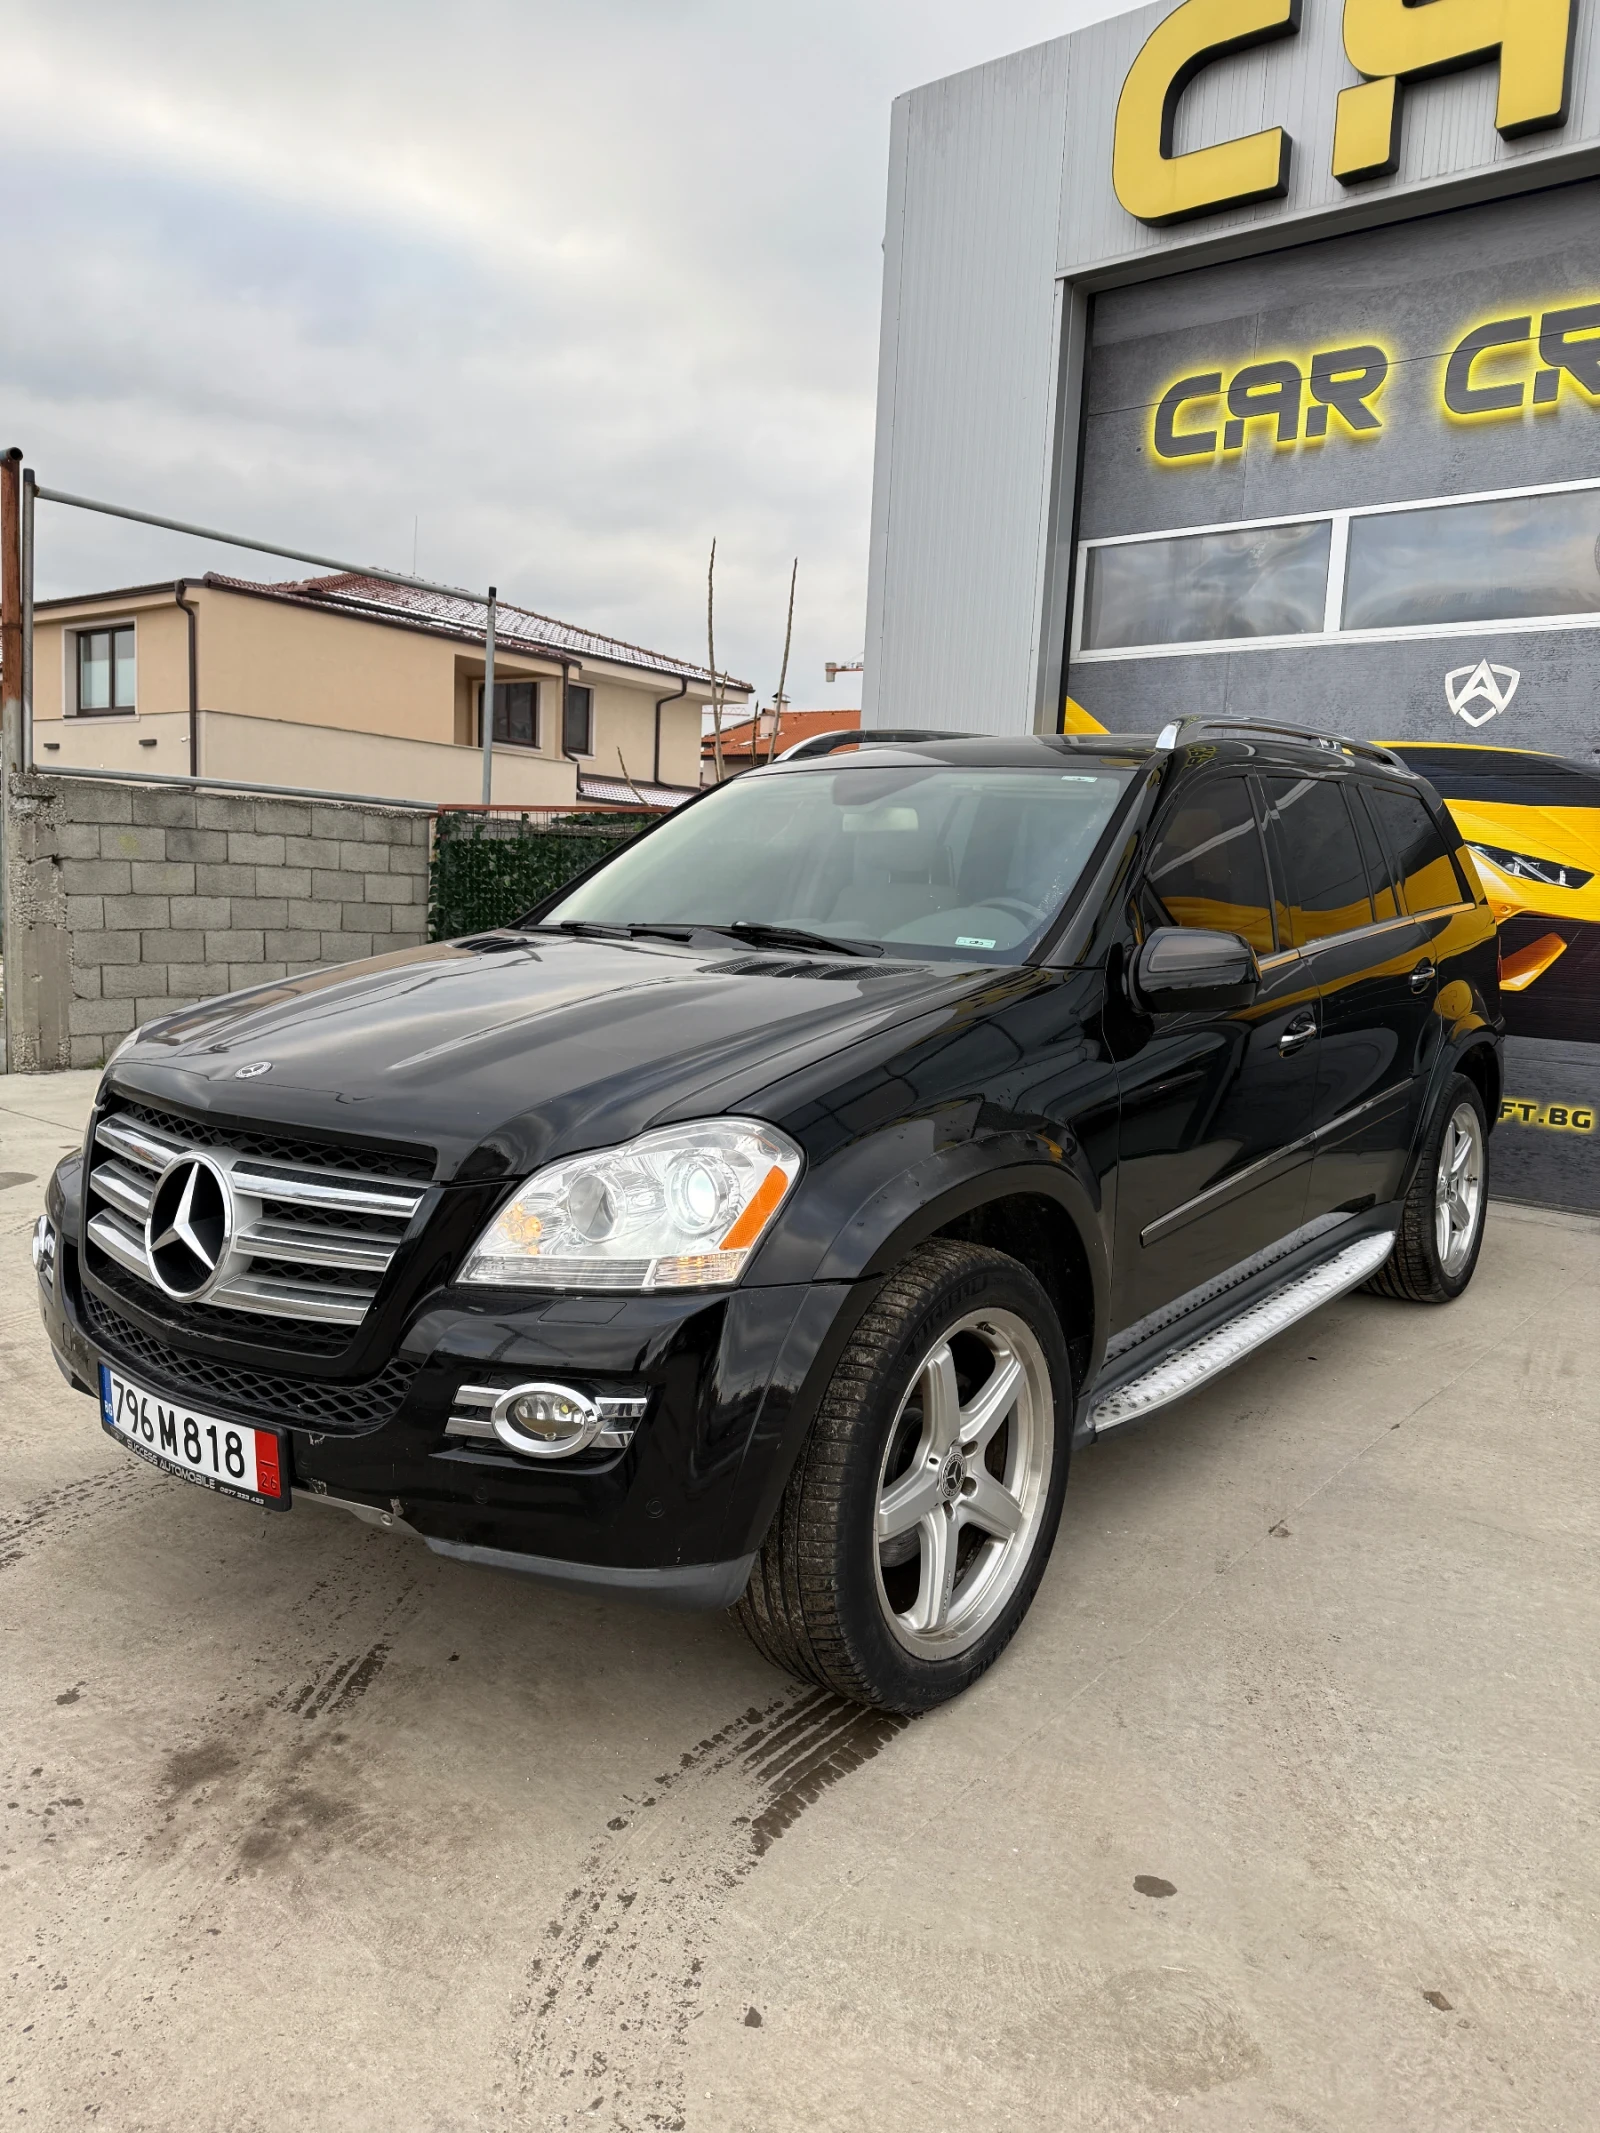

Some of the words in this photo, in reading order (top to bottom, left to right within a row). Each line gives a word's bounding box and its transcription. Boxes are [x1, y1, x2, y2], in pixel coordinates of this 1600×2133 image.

[1154, 344, 1389, 459] CAR
[126, 1439, 158, 1466] SUCCESS
[159, 1459, 216, 1490] AUTOMOBILE
[260, 1471, 277, 1490] 26
